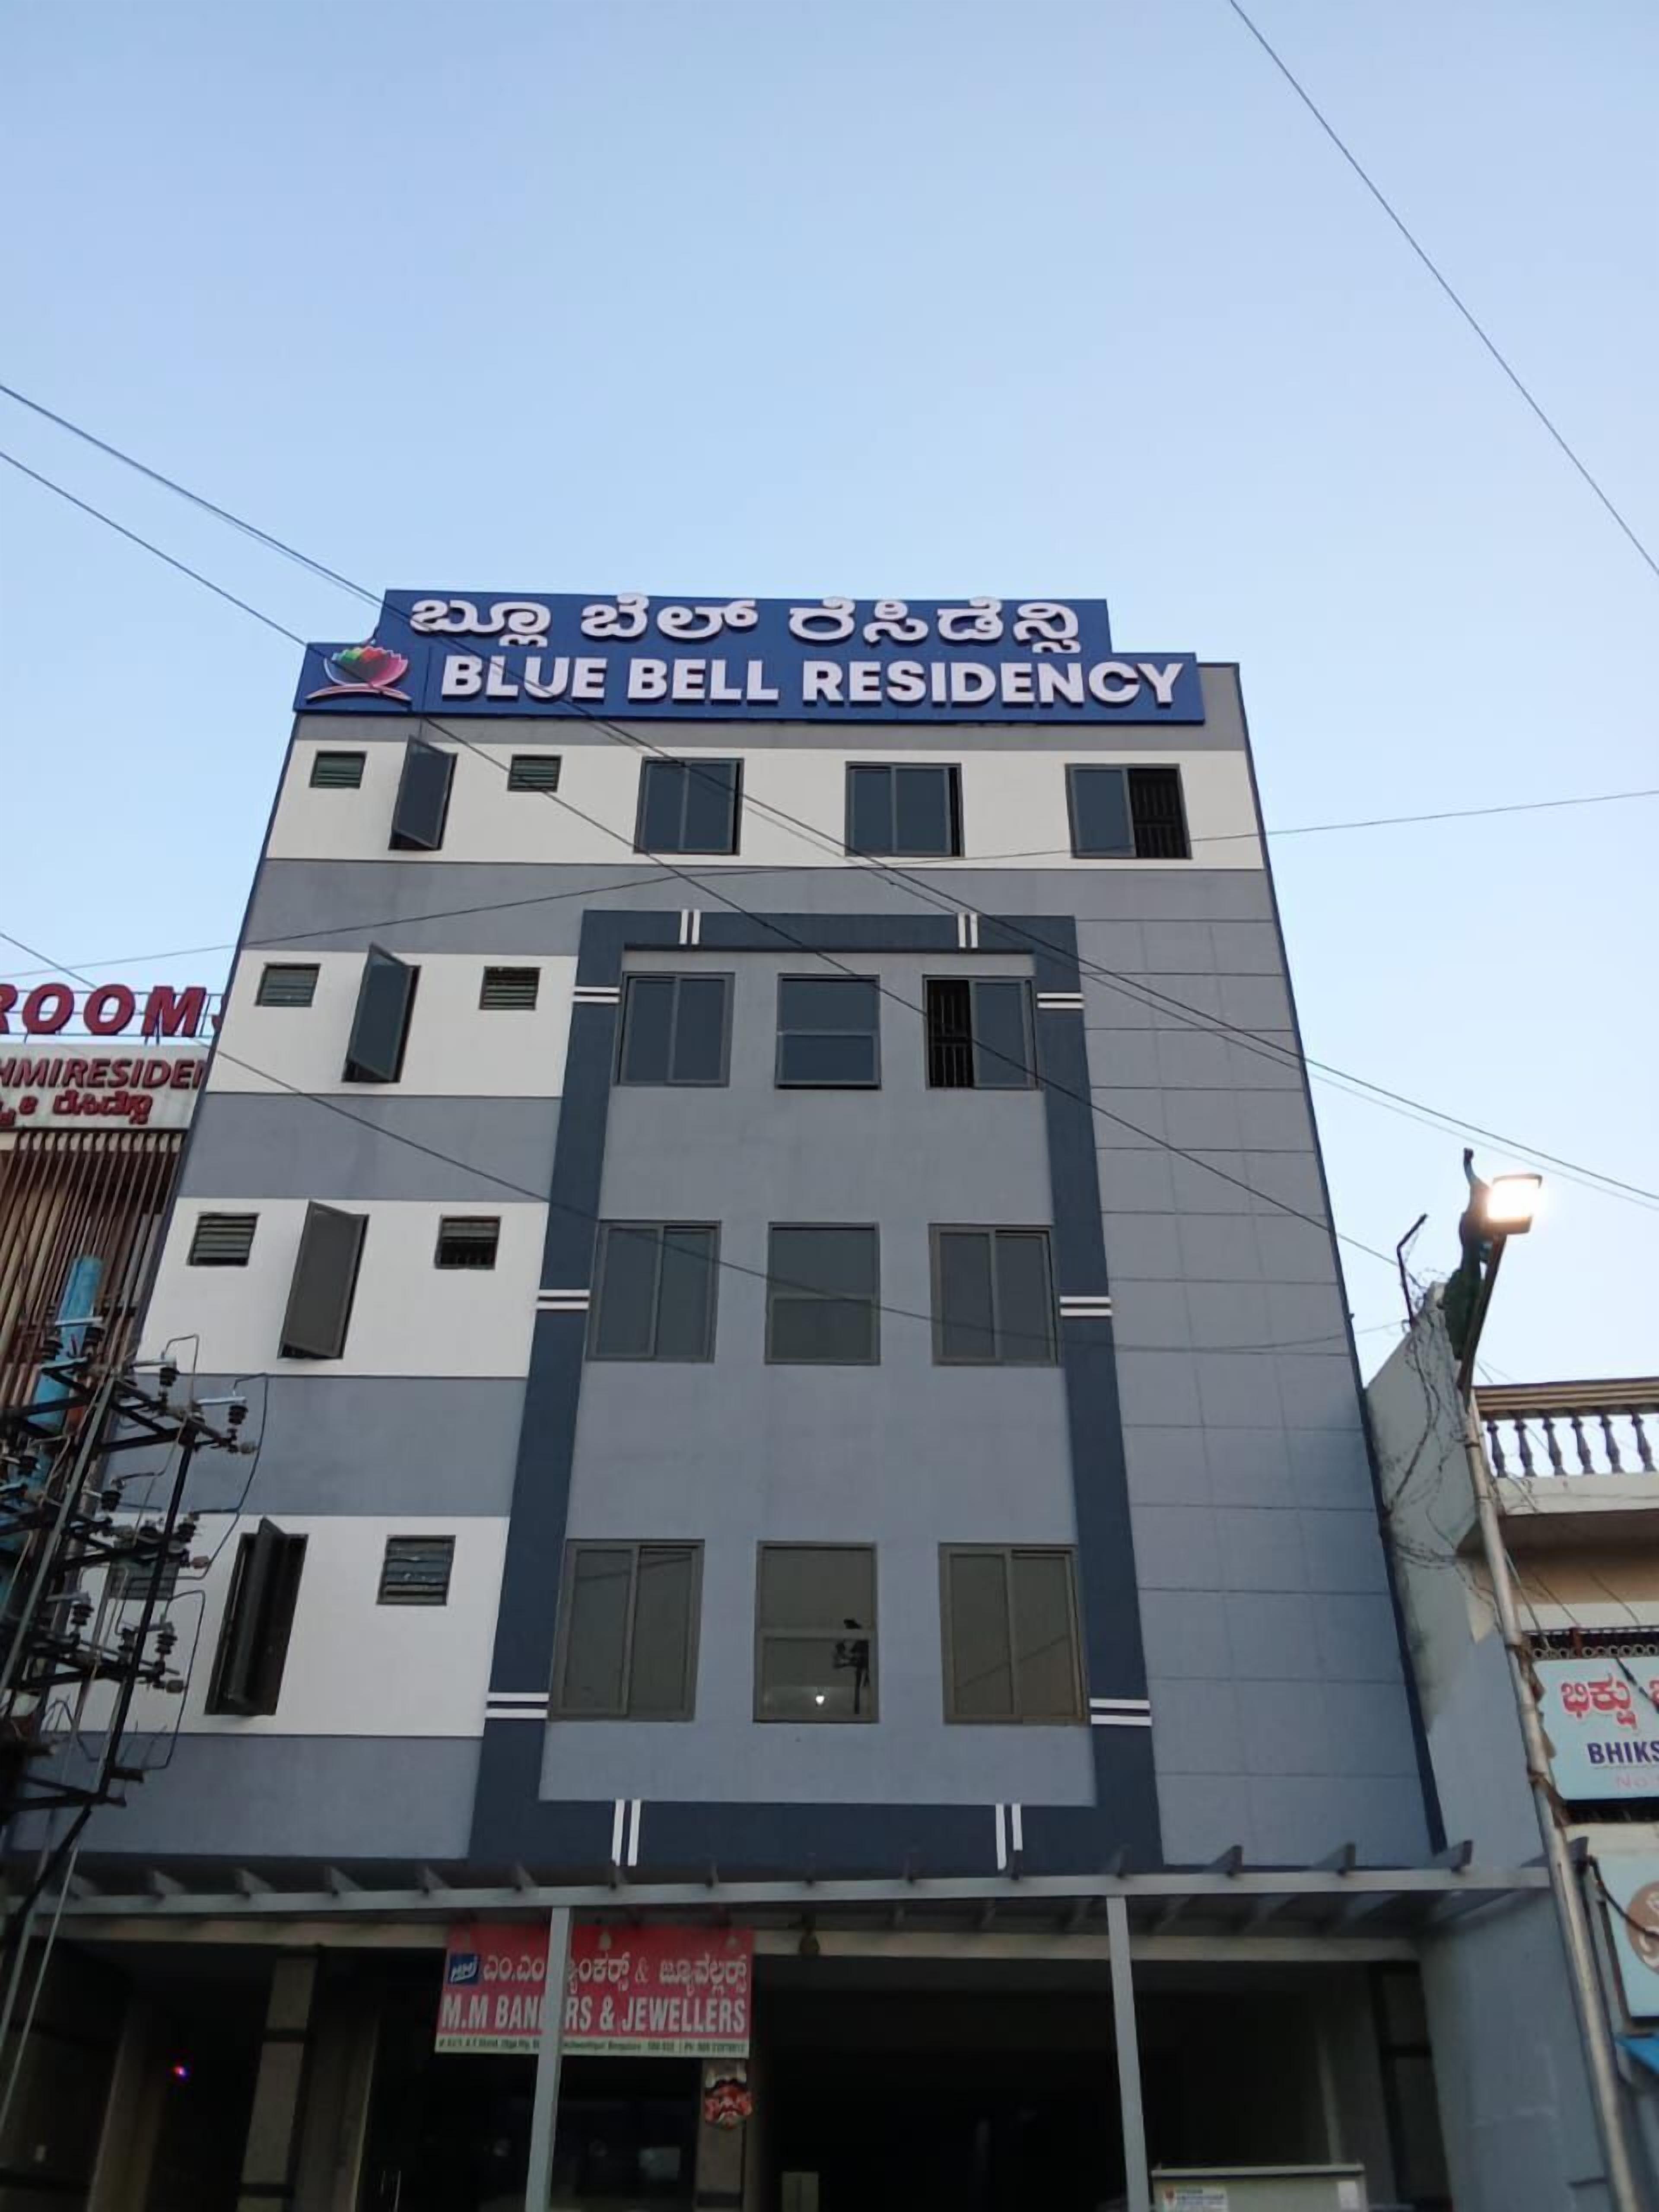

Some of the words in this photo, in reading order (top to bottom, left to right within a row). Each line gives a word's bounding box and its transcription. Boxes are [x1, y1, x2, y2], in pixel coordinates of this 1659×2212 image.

[410, 598, 551, 648] ಬ್ಲೂ
[581, 592, 758, 639] ಬೆಲ್
[441, 655, 607, 700] BLUE
[627, 658, 779, 703] BELL
[802, 660, 1184, 706] RESIDENCY
[442, 1994, 488, 2030] M.M
[495, 1995, 591, 2031] BANRS
[600, 1998, 615, 2030] &
[623, 1998, 746, 2032] JEWELLERS
